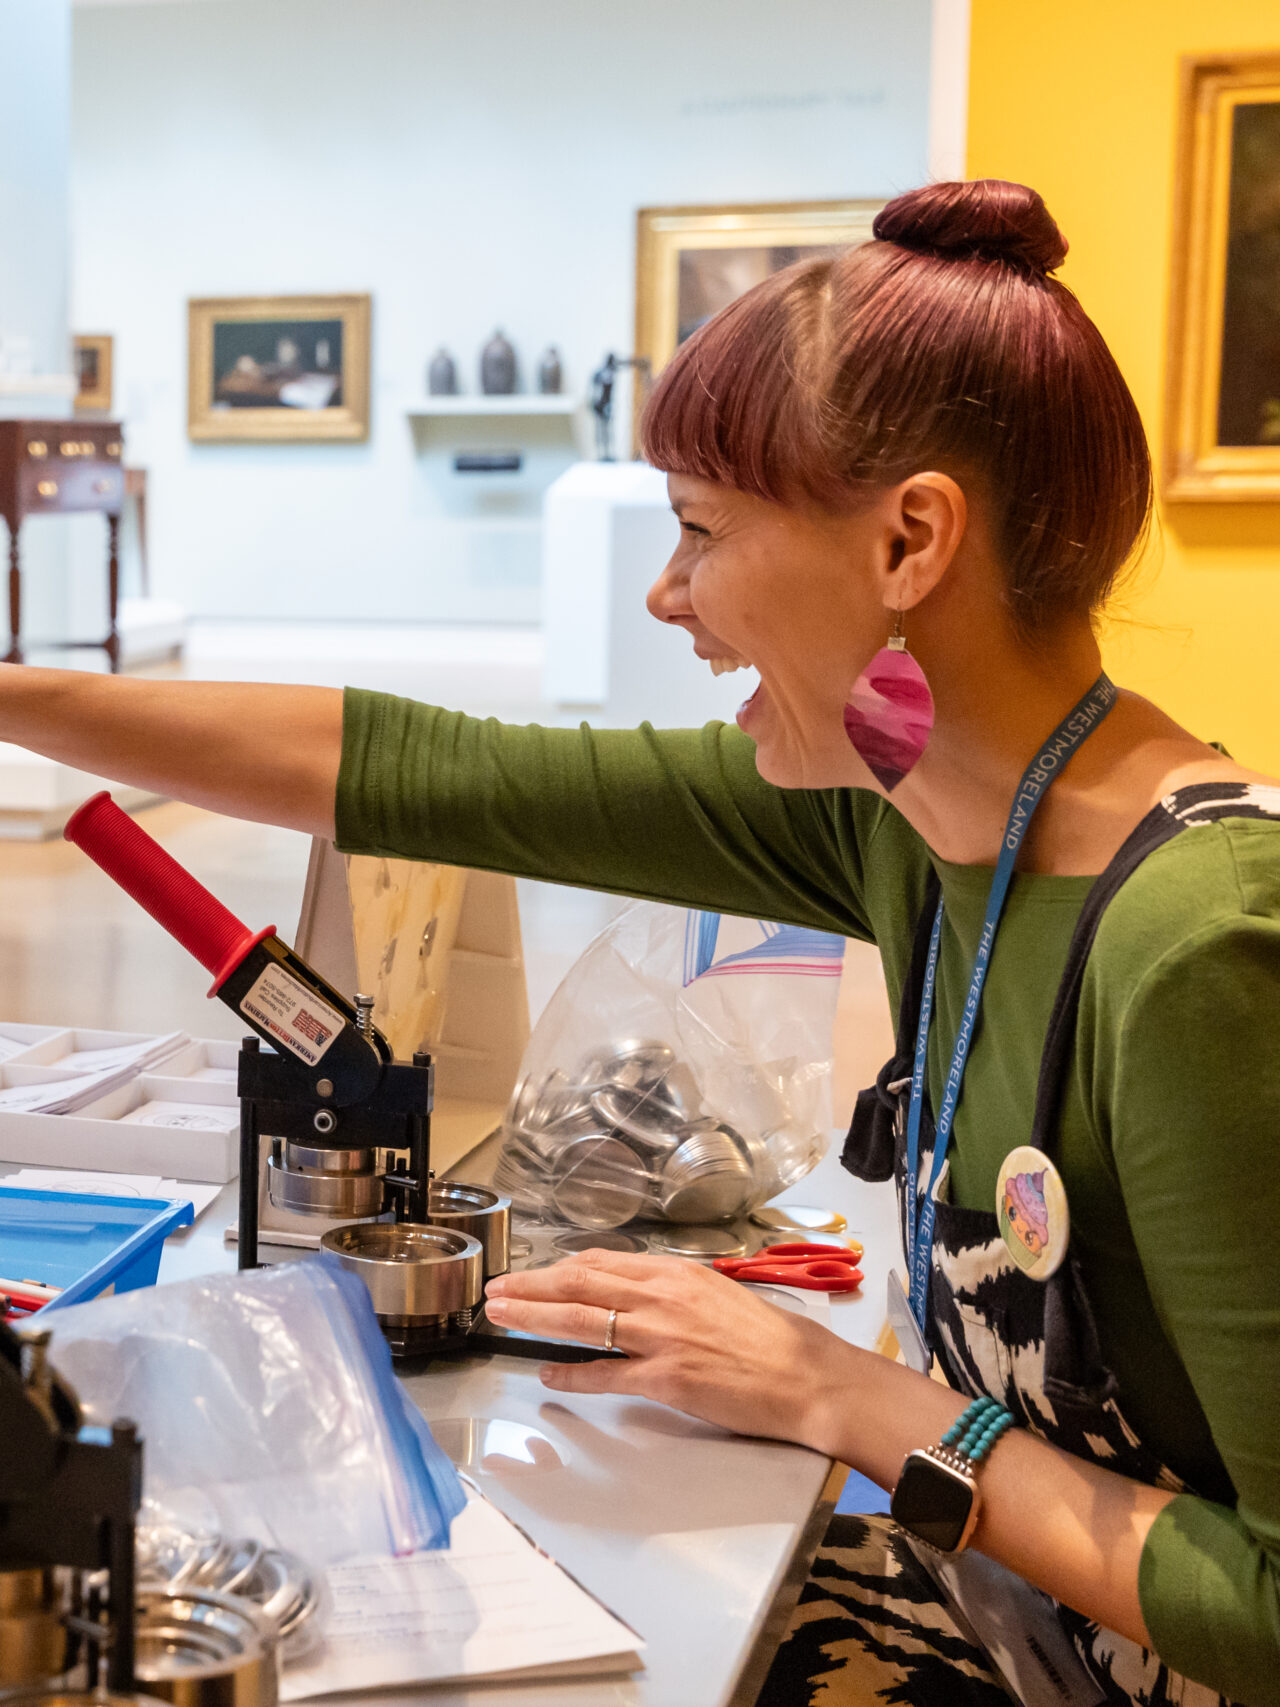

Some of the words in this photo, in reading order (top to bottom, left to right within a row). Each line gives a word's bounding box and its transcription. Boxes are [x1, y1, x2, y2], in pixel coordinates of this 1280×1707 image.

[1006, 701, 1103, 850] WESTMORELAND
[978, 921, 995, 959] THE
[940, 966, 984, 1135] WESTMORELAND
[913, 1064, 922, 1100] THE
[921, 1200, 935, 1240] THE
